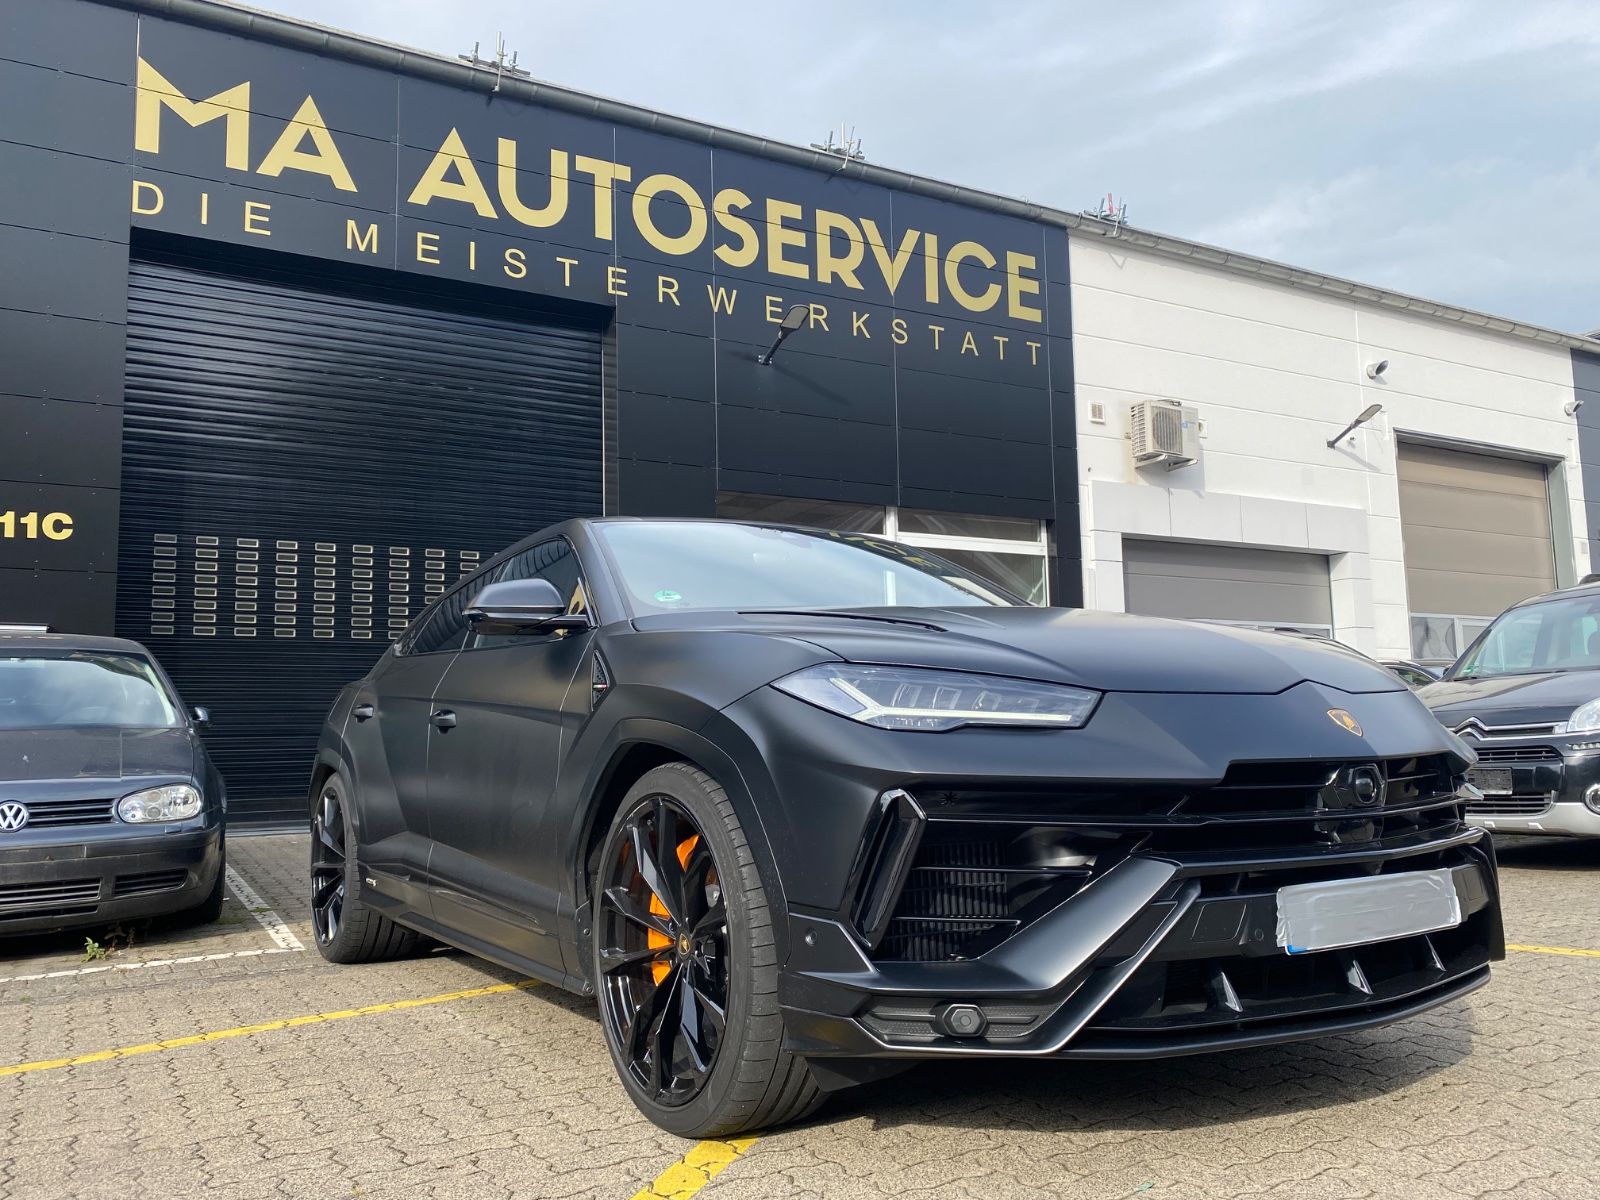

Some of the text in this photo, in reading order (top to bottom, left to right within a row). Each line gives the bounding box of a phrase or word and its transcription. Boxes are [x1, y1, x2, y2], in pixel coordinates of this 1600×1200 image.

[132, 181, 1041, 366] DIE MEISTERWERKSTATT
[135, 57, 1042, 324] MA AUTOSERVICE
[0, 510, 74, 540] 11C
